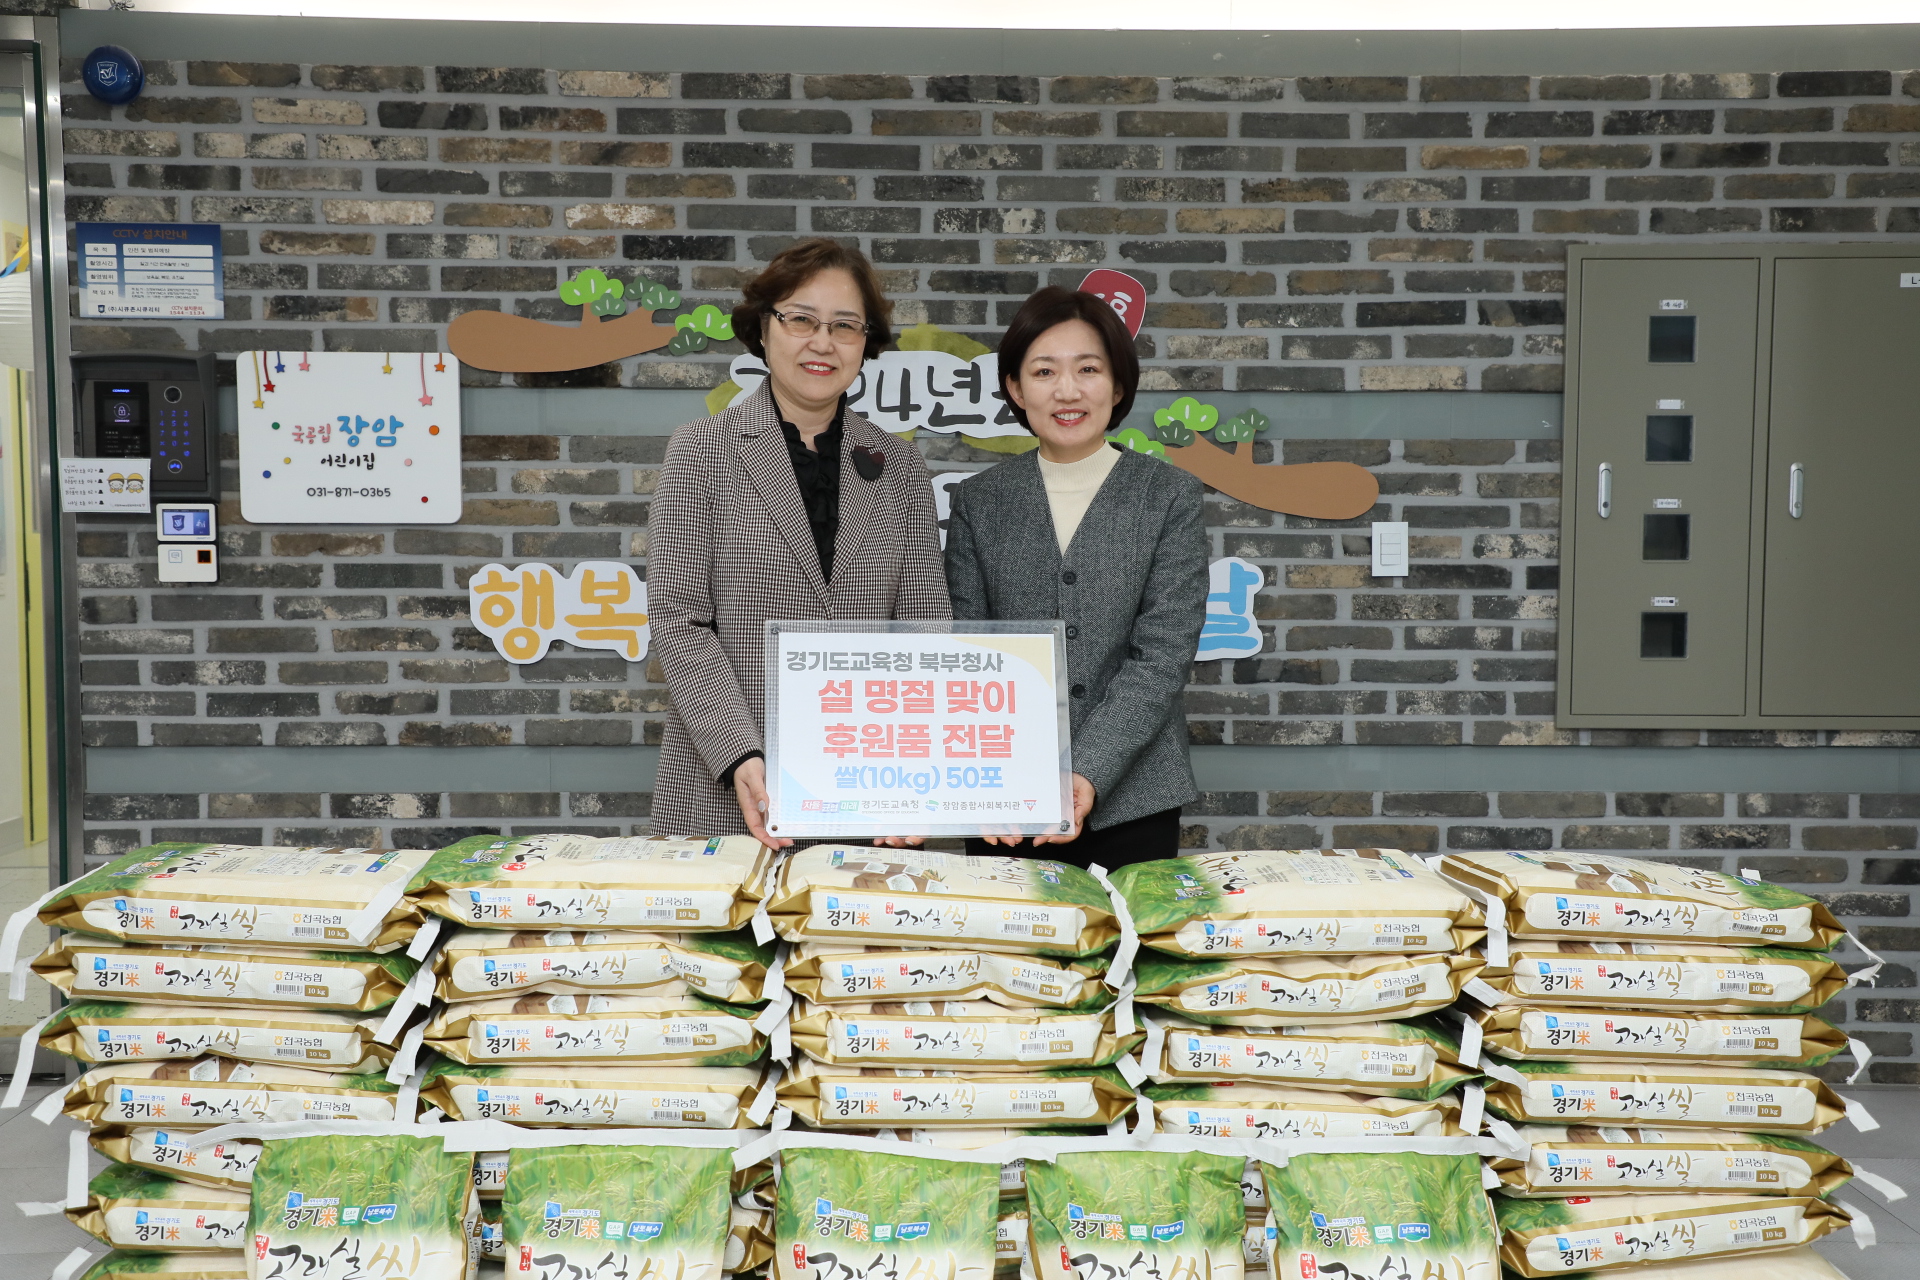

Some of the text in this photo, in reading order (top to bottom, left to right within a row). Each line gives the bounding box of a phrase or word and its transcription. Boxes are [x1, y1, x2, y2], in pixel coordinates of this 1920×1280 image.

[113, 229, 188, 240] CCTV 설치안내
[292, 415, 404, 447] 국공립 장암
[321, 453, 375, 470] 어린이집
[307, 487, 391, 497] 031-871-0365
[786, 652, 1003, 673] 경기도교육청 북부청사
[818, 680, 1016, 714] 설 명절 맞이
[823, 723, 1014, 758] 후원품 전달
[834, 765, 1003, 795] 쌀(10kg) 50포
[862, 800, 919, 809] 경기도교육청
[942, 801, 1021, 811] 장암종합사회복지관
[654, 896, 692, 907] 전곡농협
[302, 914, 342, 924] 전곡농협
[1012, 911, 1050, 922] 전곡농협
[1741, 911, 1779, 922] 전곡농협
[1383, 923, 1420, 933] 전곡농협
[283, 971, 323, 982] 전곡농협
[1021, 968, 1056, 983] 전곡농협
[1725, 969, 1764, 980] 전곡농협
[1382, 974, 1420, 988] 전곡농협
[671, 1023, 708, 1033] 전곡농협
[1731, 1025, 1771, 1035] 전곡농협
[1028, 1029, 1065, 1040] 전곡농협
[282, 1036, 323, 1047] 전곡농협
[1370, 1050, 1408, 1062] 전곡농협
[1019, 1089, 1057, 1099] 전곡농협
[1735, 1091, 1774, 1102] 전곡농협
[312, 1100, 350, 1112] 전곡농협
[661, 1098, 699, 1108] 전곡농협
[1371, 1120, 1409, 1131] 전곡농협
[1734, 1157, 1771, 1168] 전곡농협
[283, 1207, 338, 1230] 경기米
[851, 1211, 868, 1221] 경기도
[1104, 1214, 1122, 1222] 경기도
[1346, 1217, 1365, 1225] 경기도
[1738, 1216, 1777, 1228] 전곡농협
[543, 1218, 600, 1239] 경기米
[814, 1215, 868, 1241] 경기米
[1070, 1219, 1125, 1240] 경기米
[1316, 1227, 1371, 1247] 경기米
